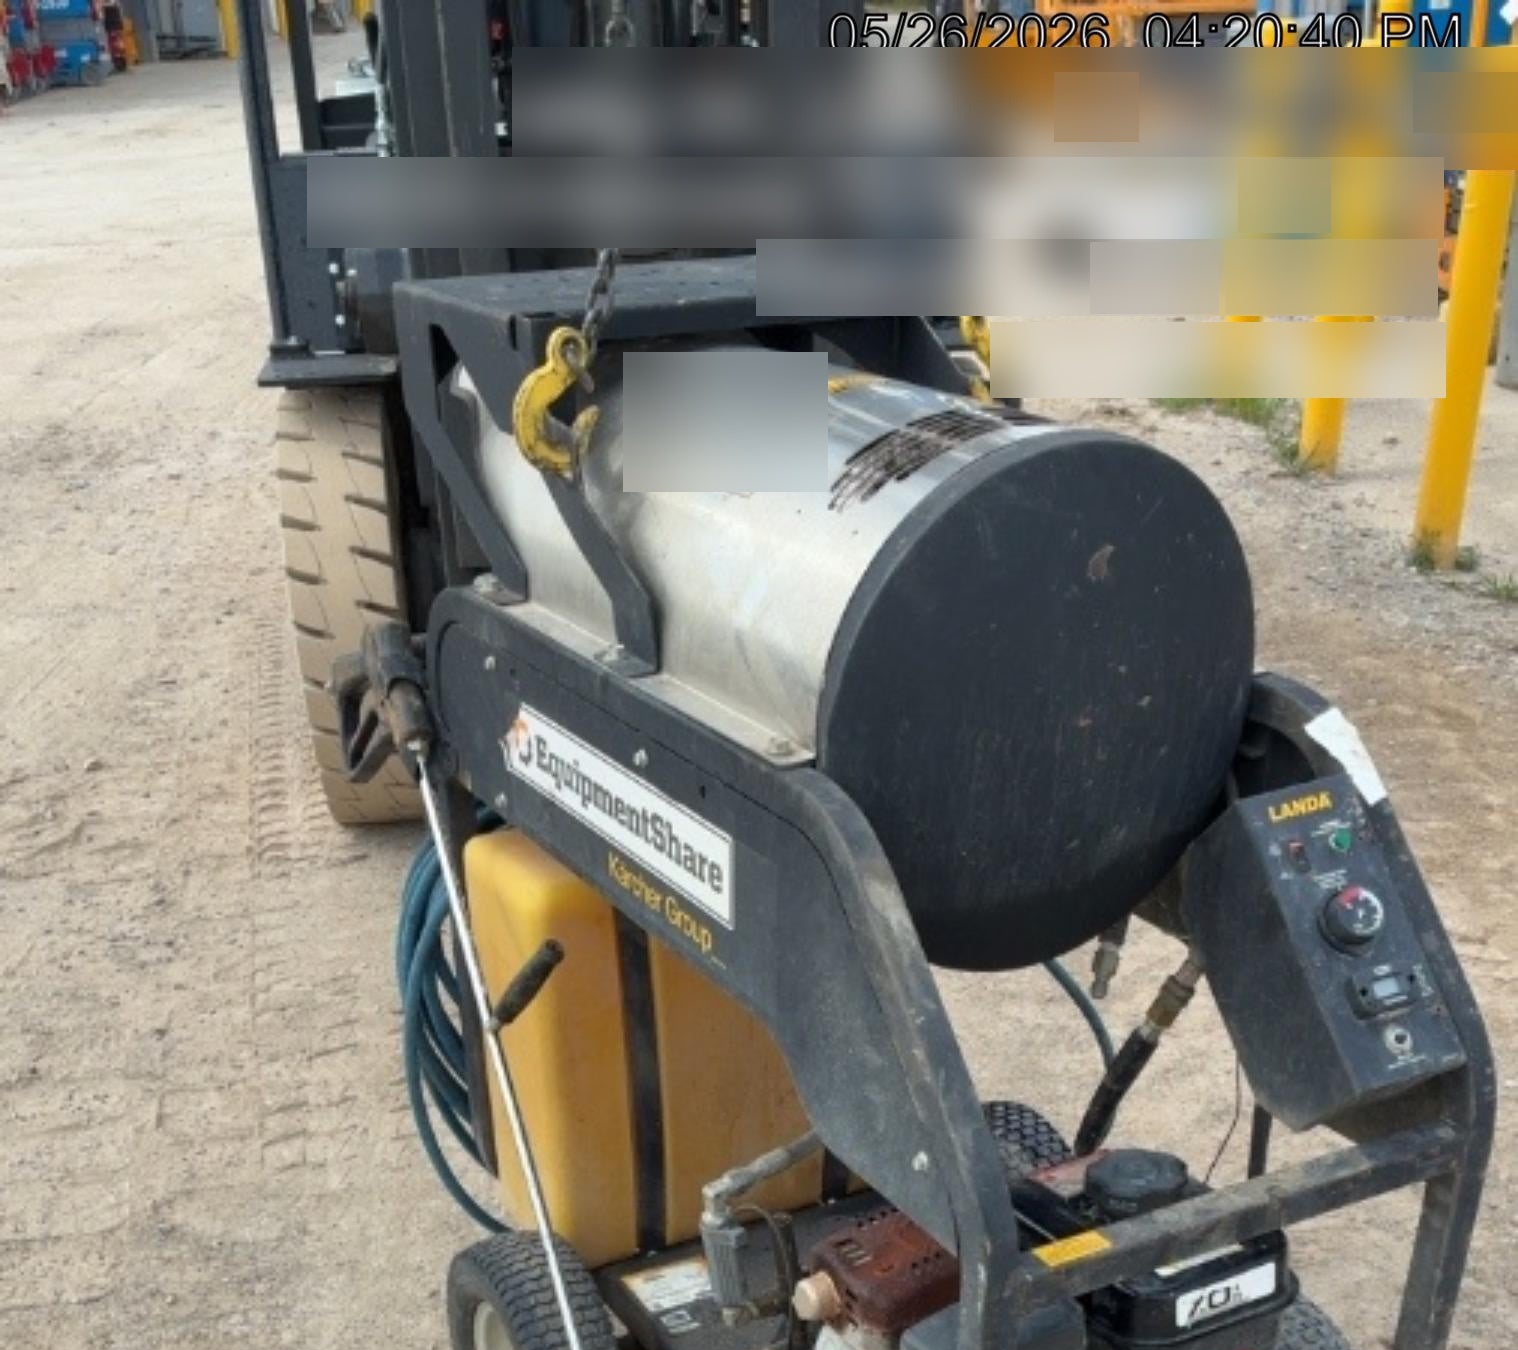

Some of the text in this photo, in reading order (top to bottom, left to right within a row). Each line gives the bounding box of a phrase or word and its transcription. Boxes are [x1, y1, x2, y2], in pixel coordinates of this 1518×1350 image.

[535, 735, 723, 894] EquipmentShare
[1268, 791, 1332, 824] LANDA
[665, 895, 712, 954] Group
